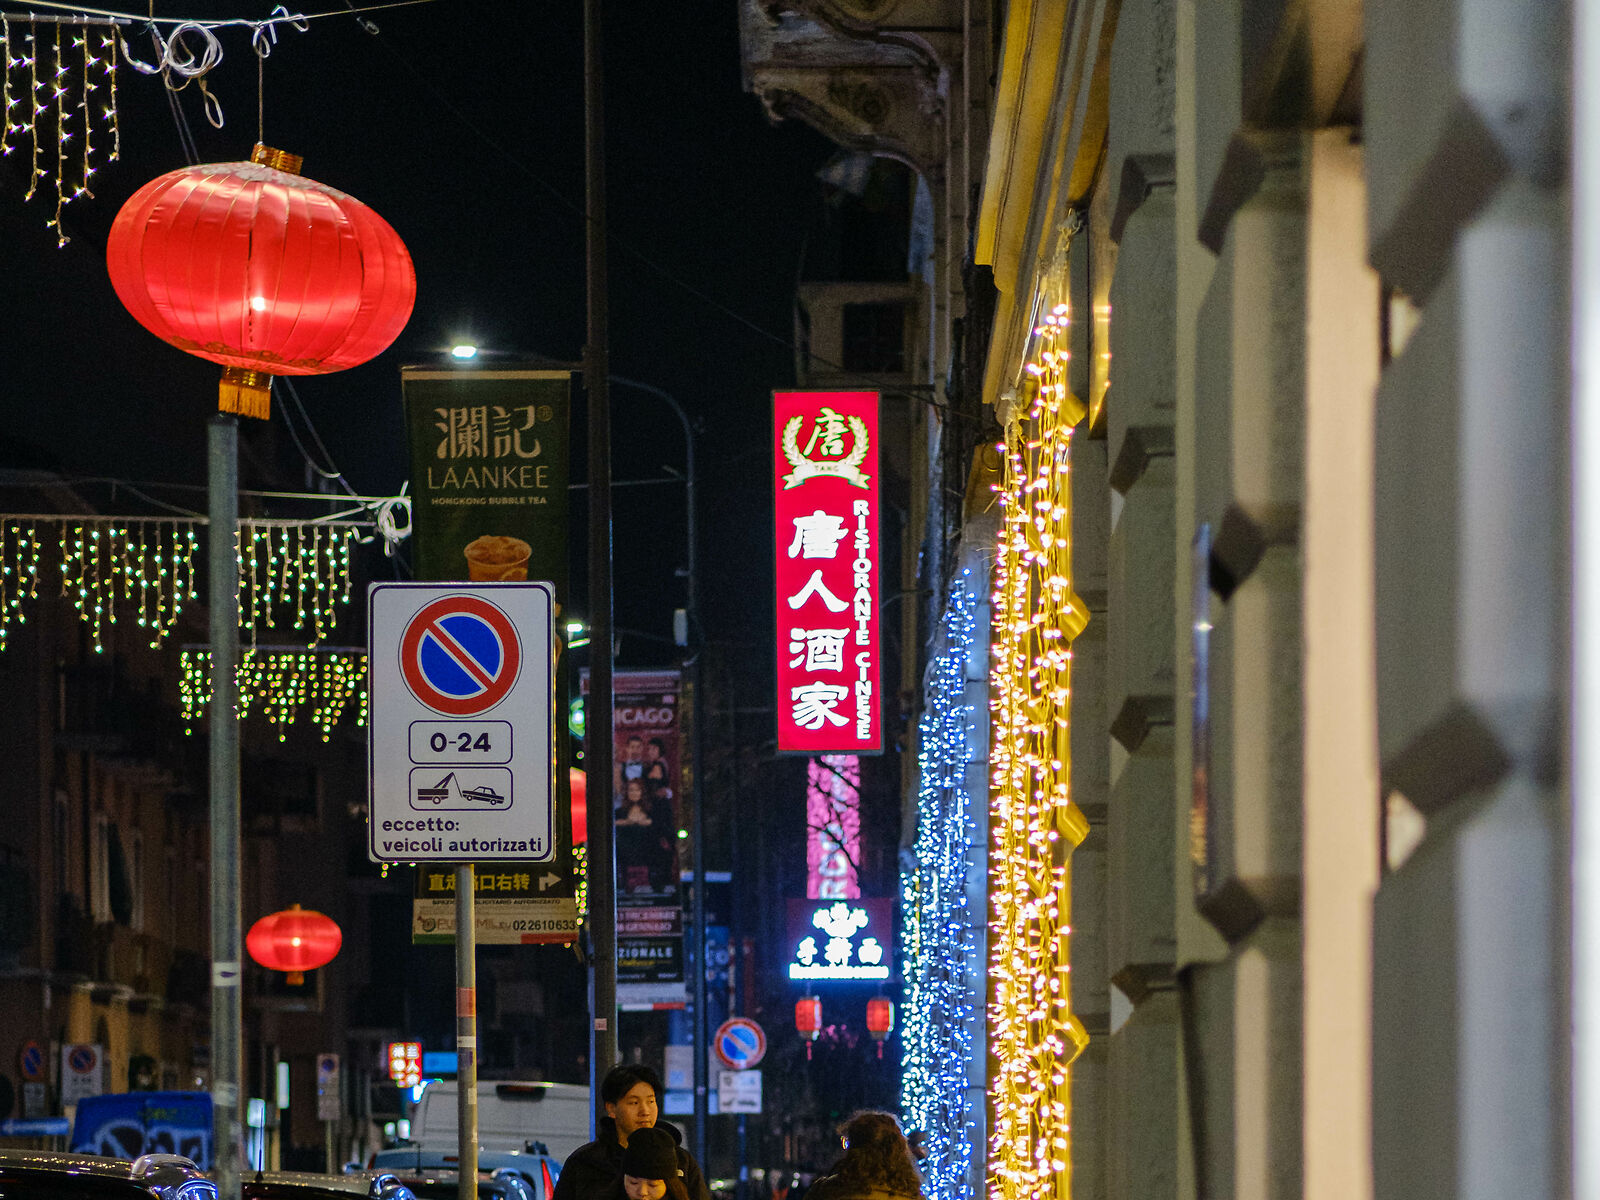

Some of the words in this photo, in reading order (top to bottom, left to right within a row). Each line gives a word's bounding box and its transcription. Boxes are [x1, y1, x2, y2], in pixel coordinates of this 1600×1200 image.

[434, 405, 541, 459] 瀾記
[803, 407, 850, 456] 唐
[427, 466, 549, 489] LAANKEE
[431, 496, 487, 505] HONGKONG
[489, 496, 526, 504] BUBBLE
[528, 496, 547, 504] TEA
[853, 499, 872, 646] RISTORANTE
[788, 510, 850, 730] 唐人酒家
[855, 652, 872, 740] CINESE
[614, 707, 674, 725] ICAGO
[430, 732, 492, 753] 0-24
[382, 817, 460, 832] eccetto:
[382, 837, 443, 852] veicoli
[448, 837, 542, 852] autorizzati
[428, 873, 531, 892] 直走口右转
[617, 947, 673, 958] ZIONALE
